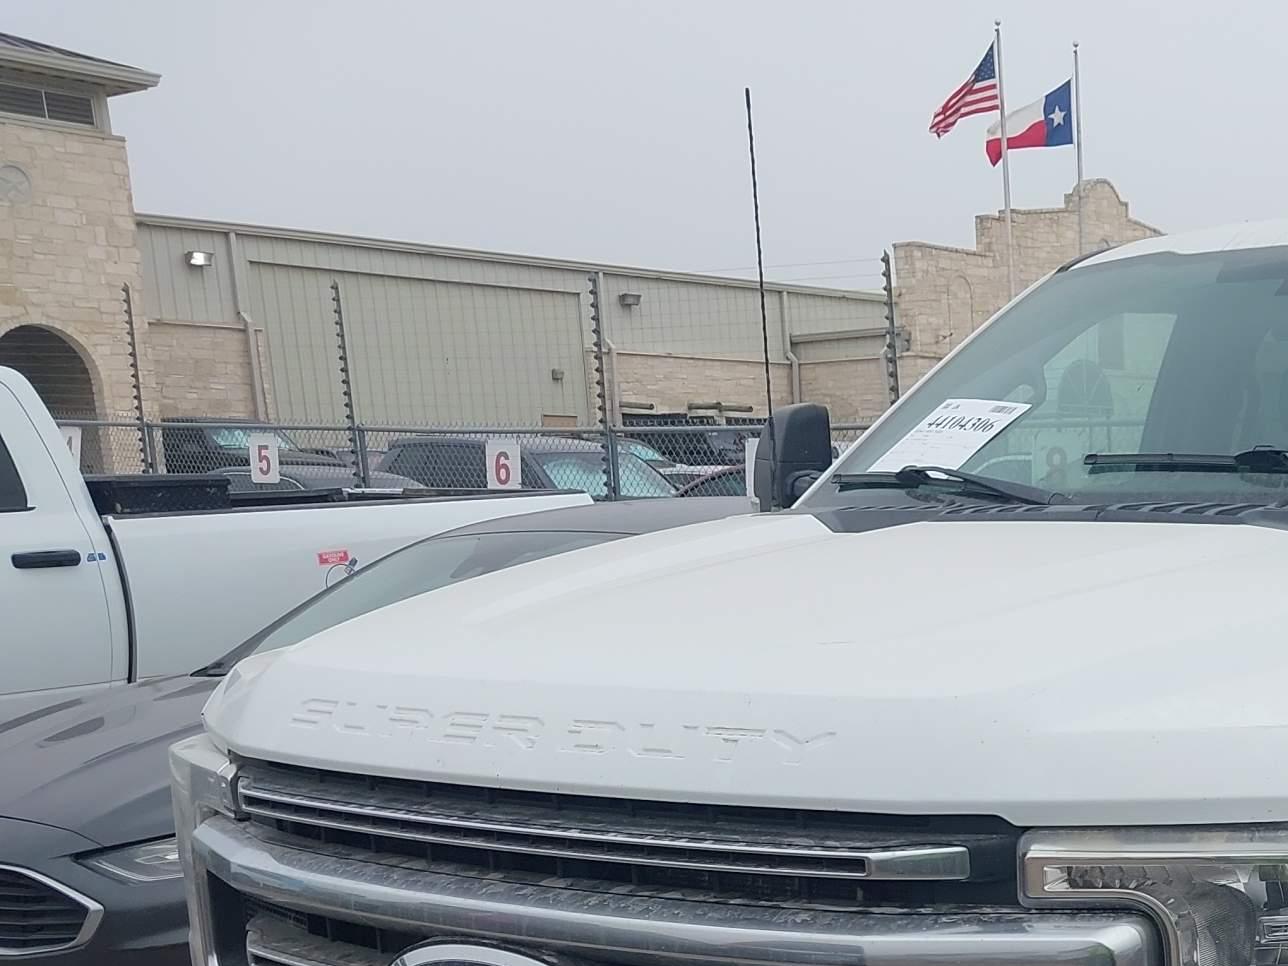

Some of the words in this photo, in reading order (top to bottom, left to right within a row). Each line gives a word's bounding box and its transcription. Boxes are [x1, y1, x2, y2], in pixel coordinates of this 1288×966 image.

[927, 415, 1000, 433] 44104306
[257, 444, 271, 476] 5
[494, 450, 511, 486] 6
[290, 697, 546, 752] SUPER
[558, 718, 837, 767] DUTY
